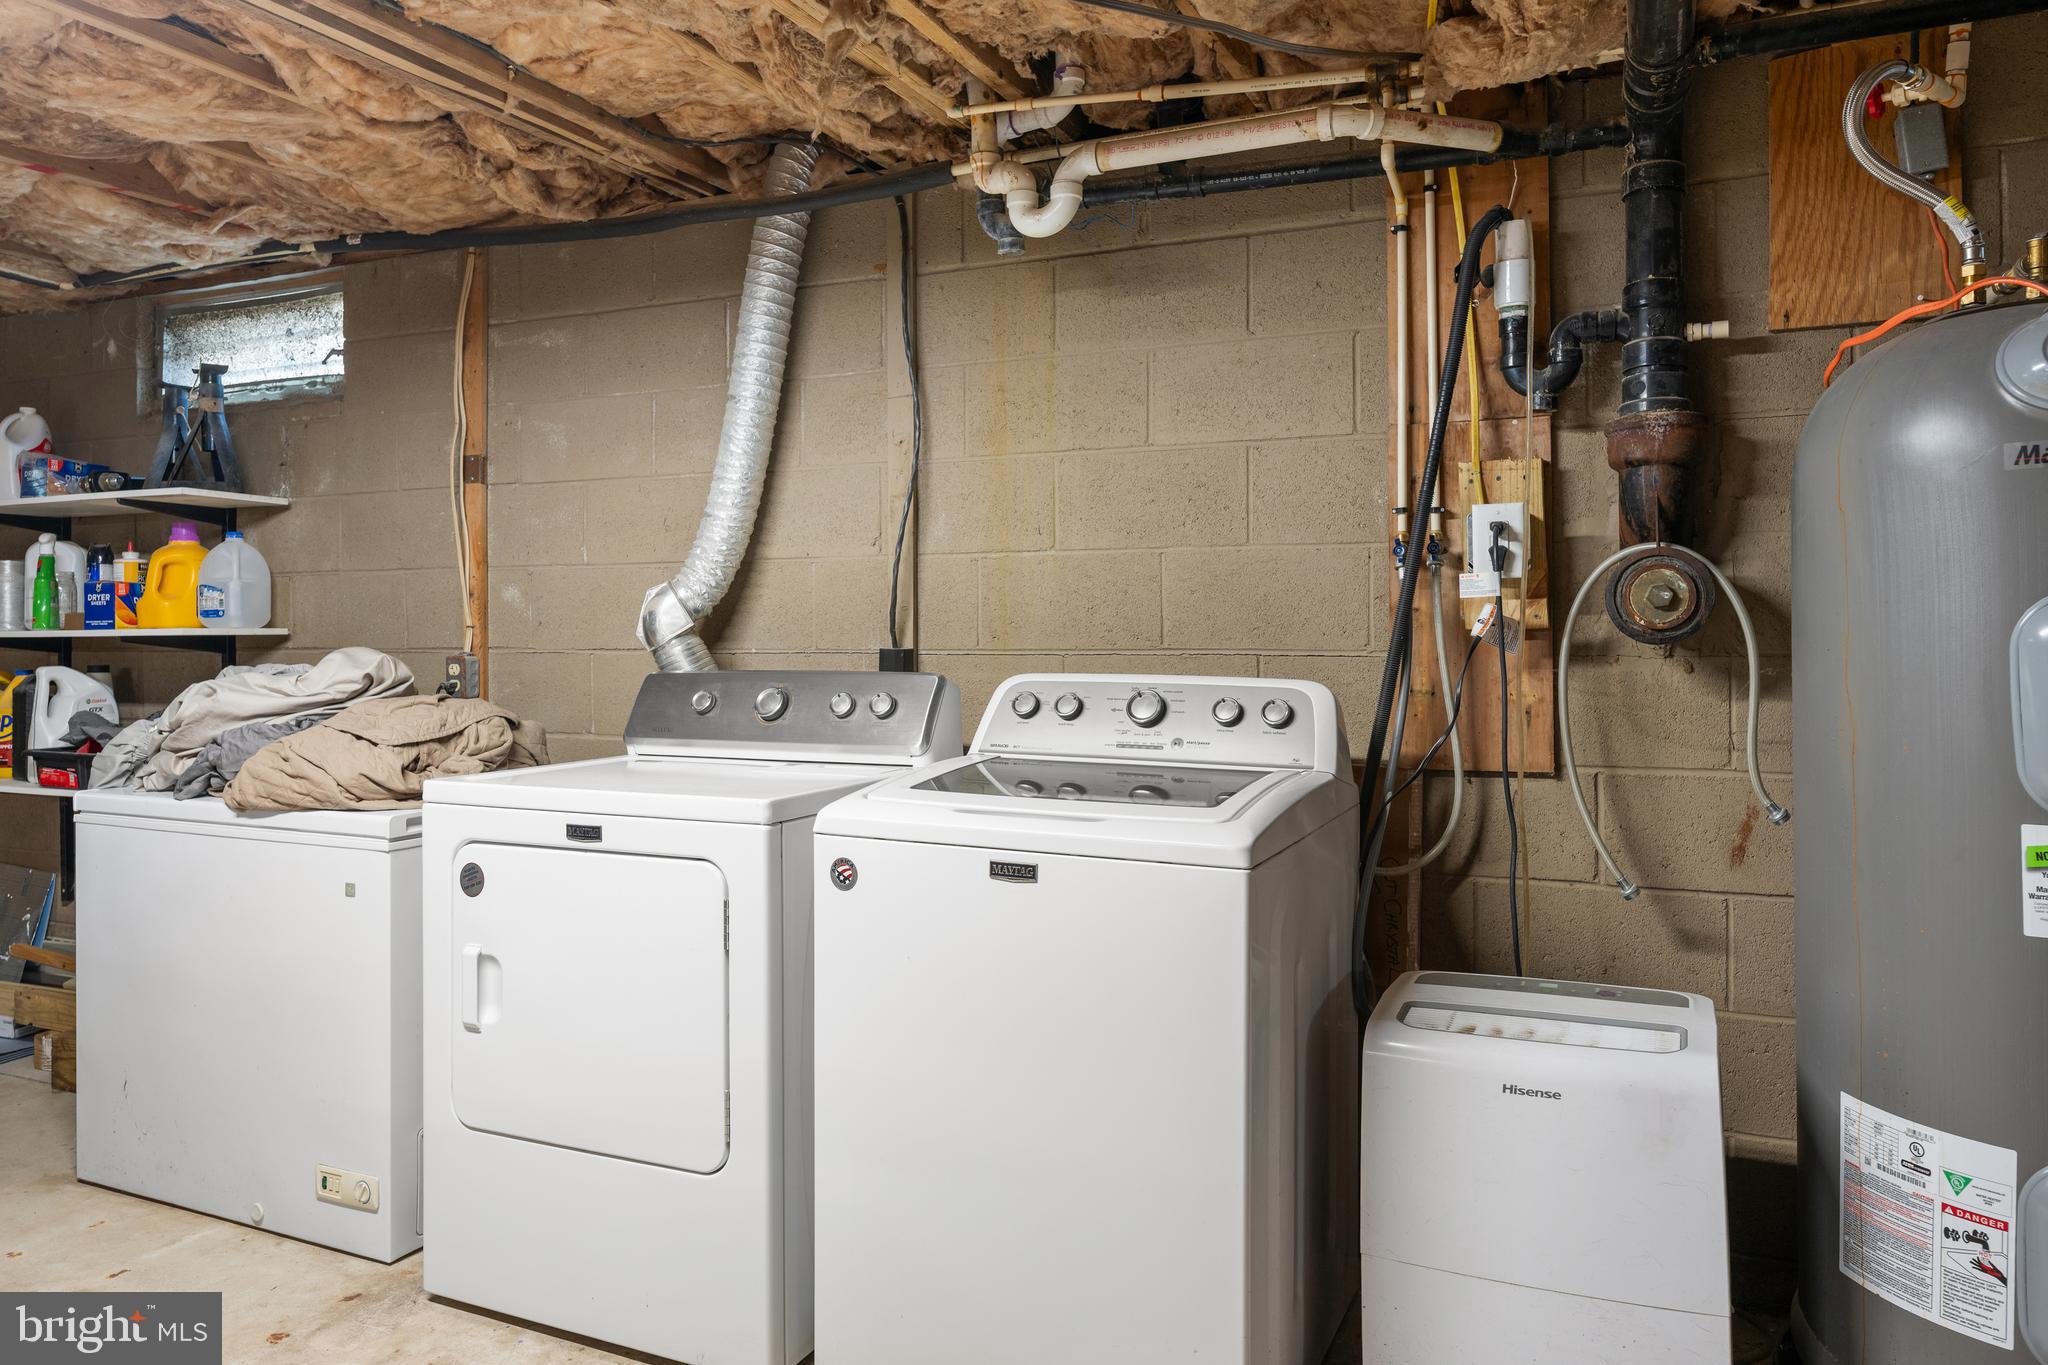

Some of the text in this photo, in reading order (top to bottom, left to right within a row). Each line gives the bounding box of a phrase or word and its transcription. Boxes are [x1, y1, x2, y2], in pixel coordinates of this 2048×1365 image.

[87, 593, 111, 602] DRYER
[991, 863, 1035, 878] MAYTAG
[1502, 1083, 1562, 1100] Hisense
[1912, 1144, 1921, 1155] UL
[1956, 1209, 2005, 1230] DANGER
